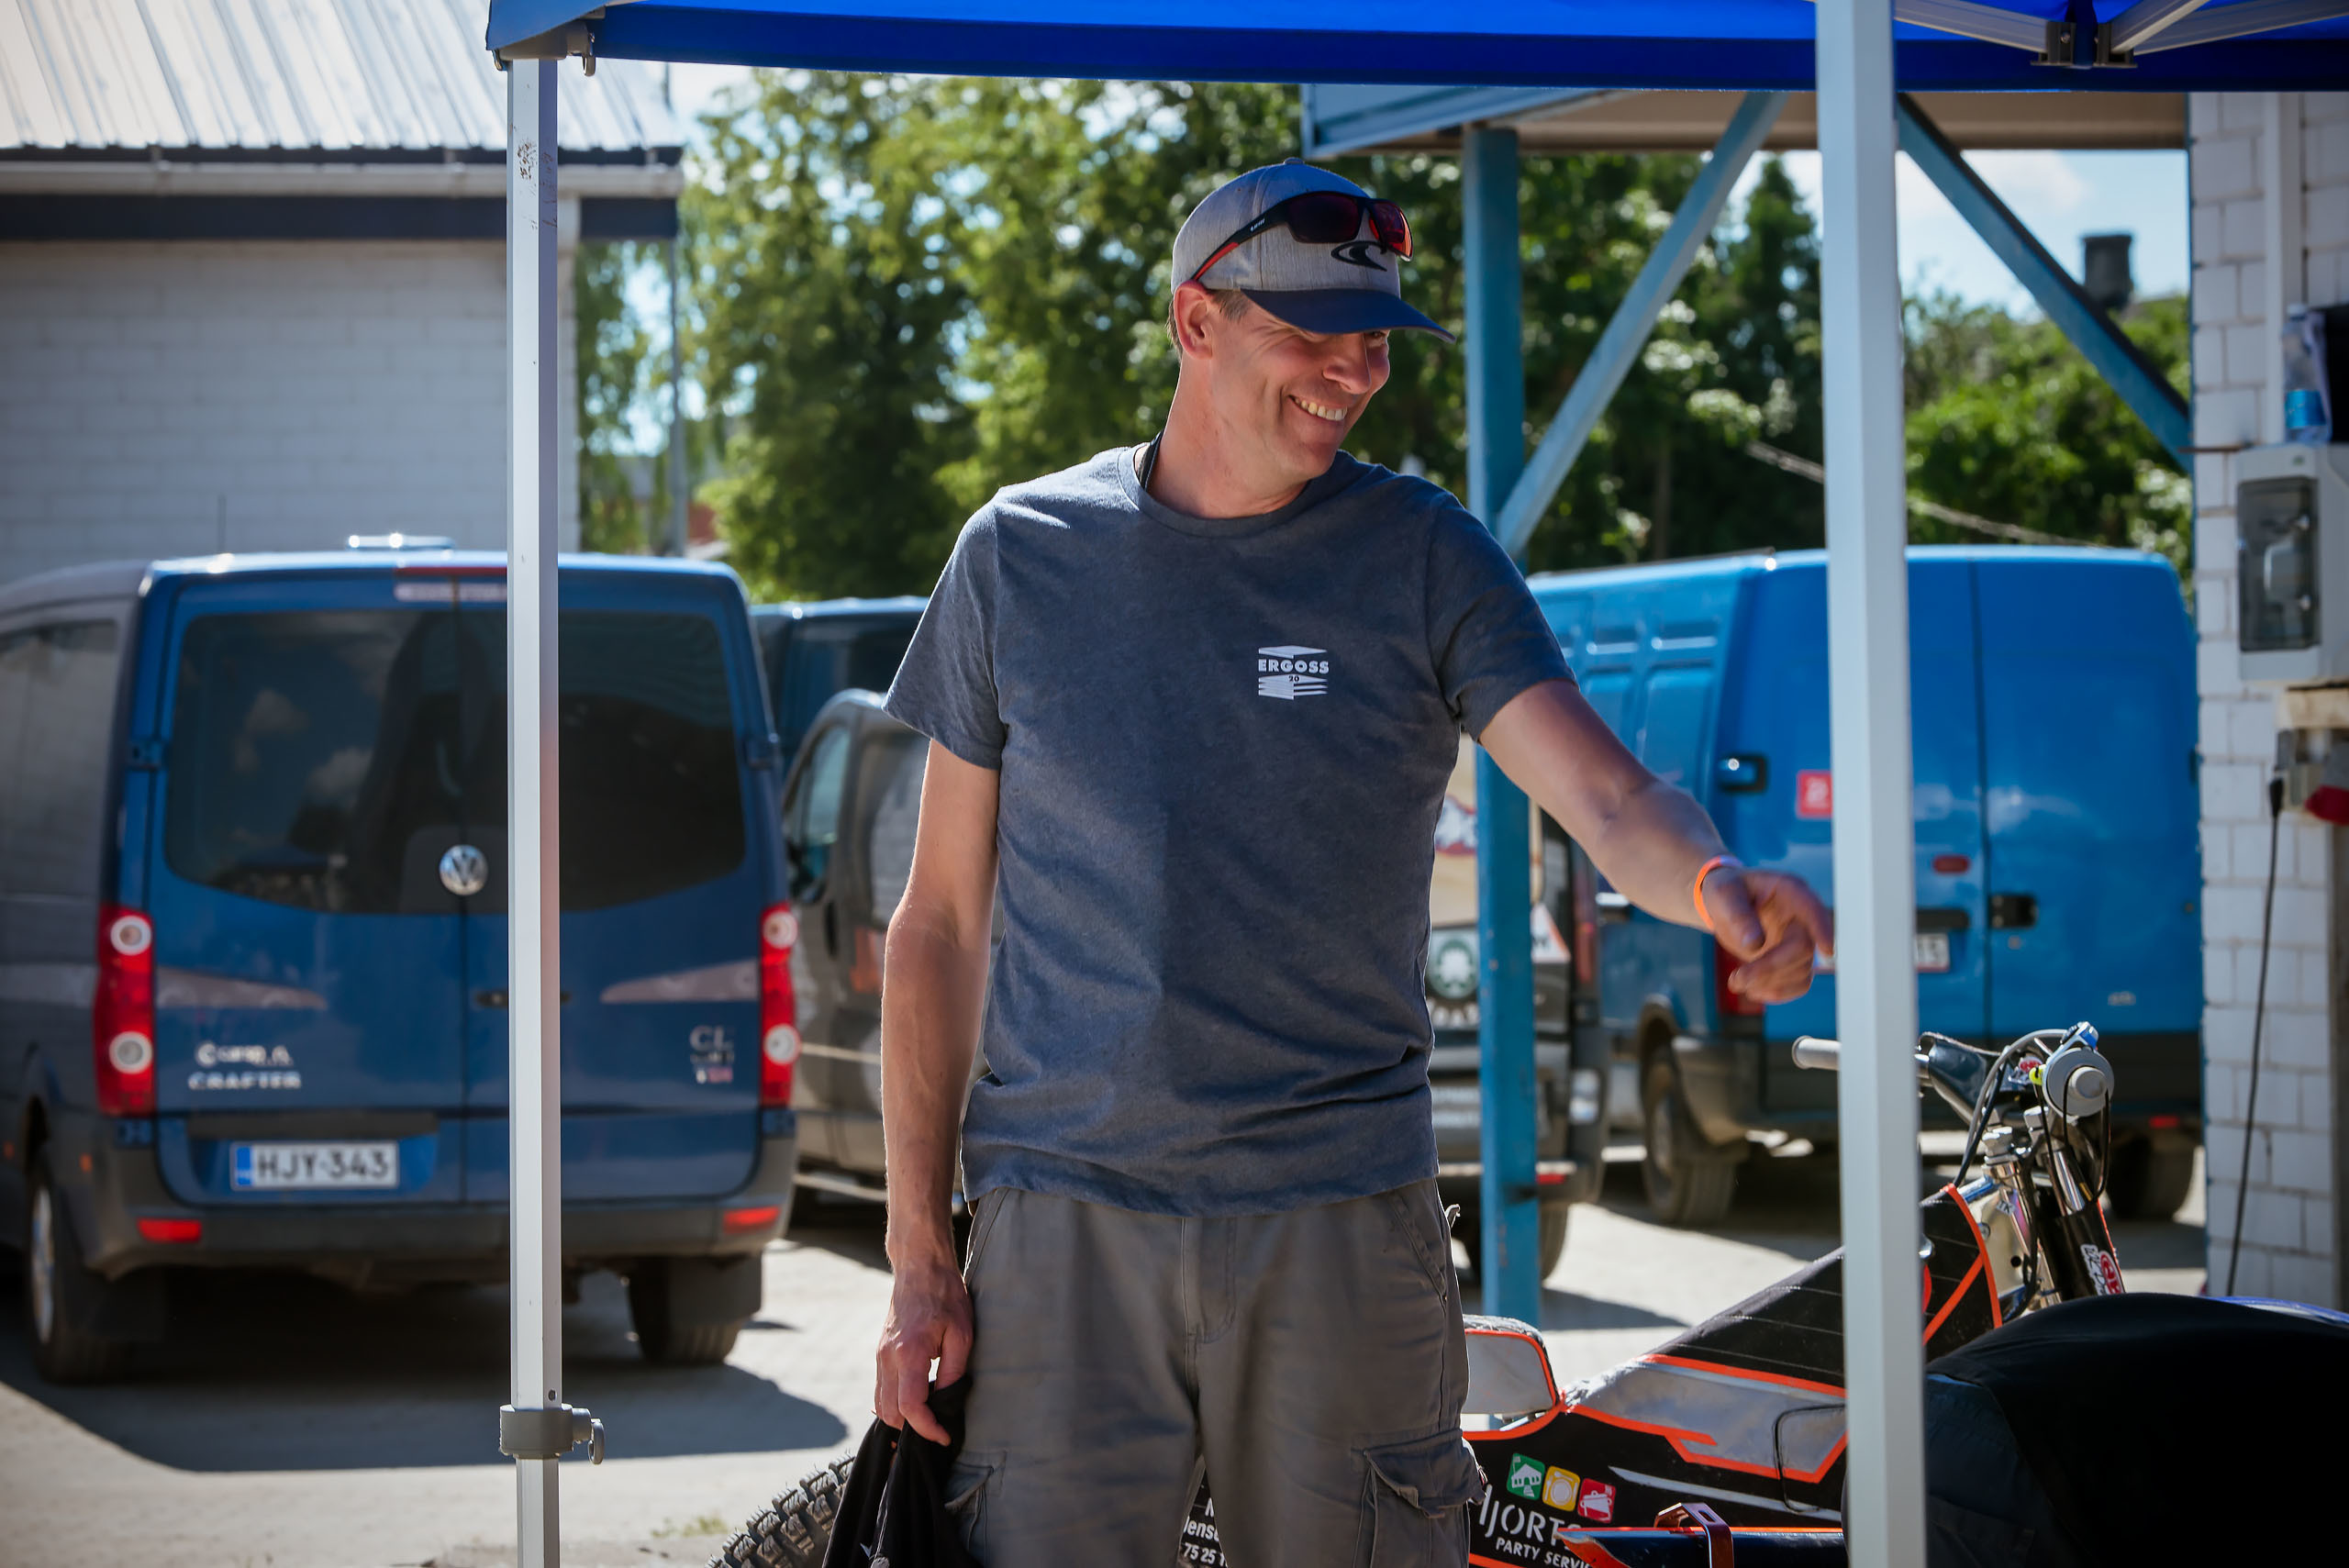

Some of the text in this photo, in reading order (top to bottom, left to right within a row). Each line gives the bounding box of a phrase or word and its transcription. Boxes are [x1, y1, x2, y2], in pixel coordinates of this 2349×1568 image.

[1258, 659, 1330, 673] ERGOSS
[257, 1150, 388, 1180] HJY-343
[1478, 1484, 1582, 1549] JORT
[1183, 1542, 1200, 1561] 75
[1200, 1548, 1217, 1565] 25
[1495, 1537, 1590, 1568] PARTY SERVI
